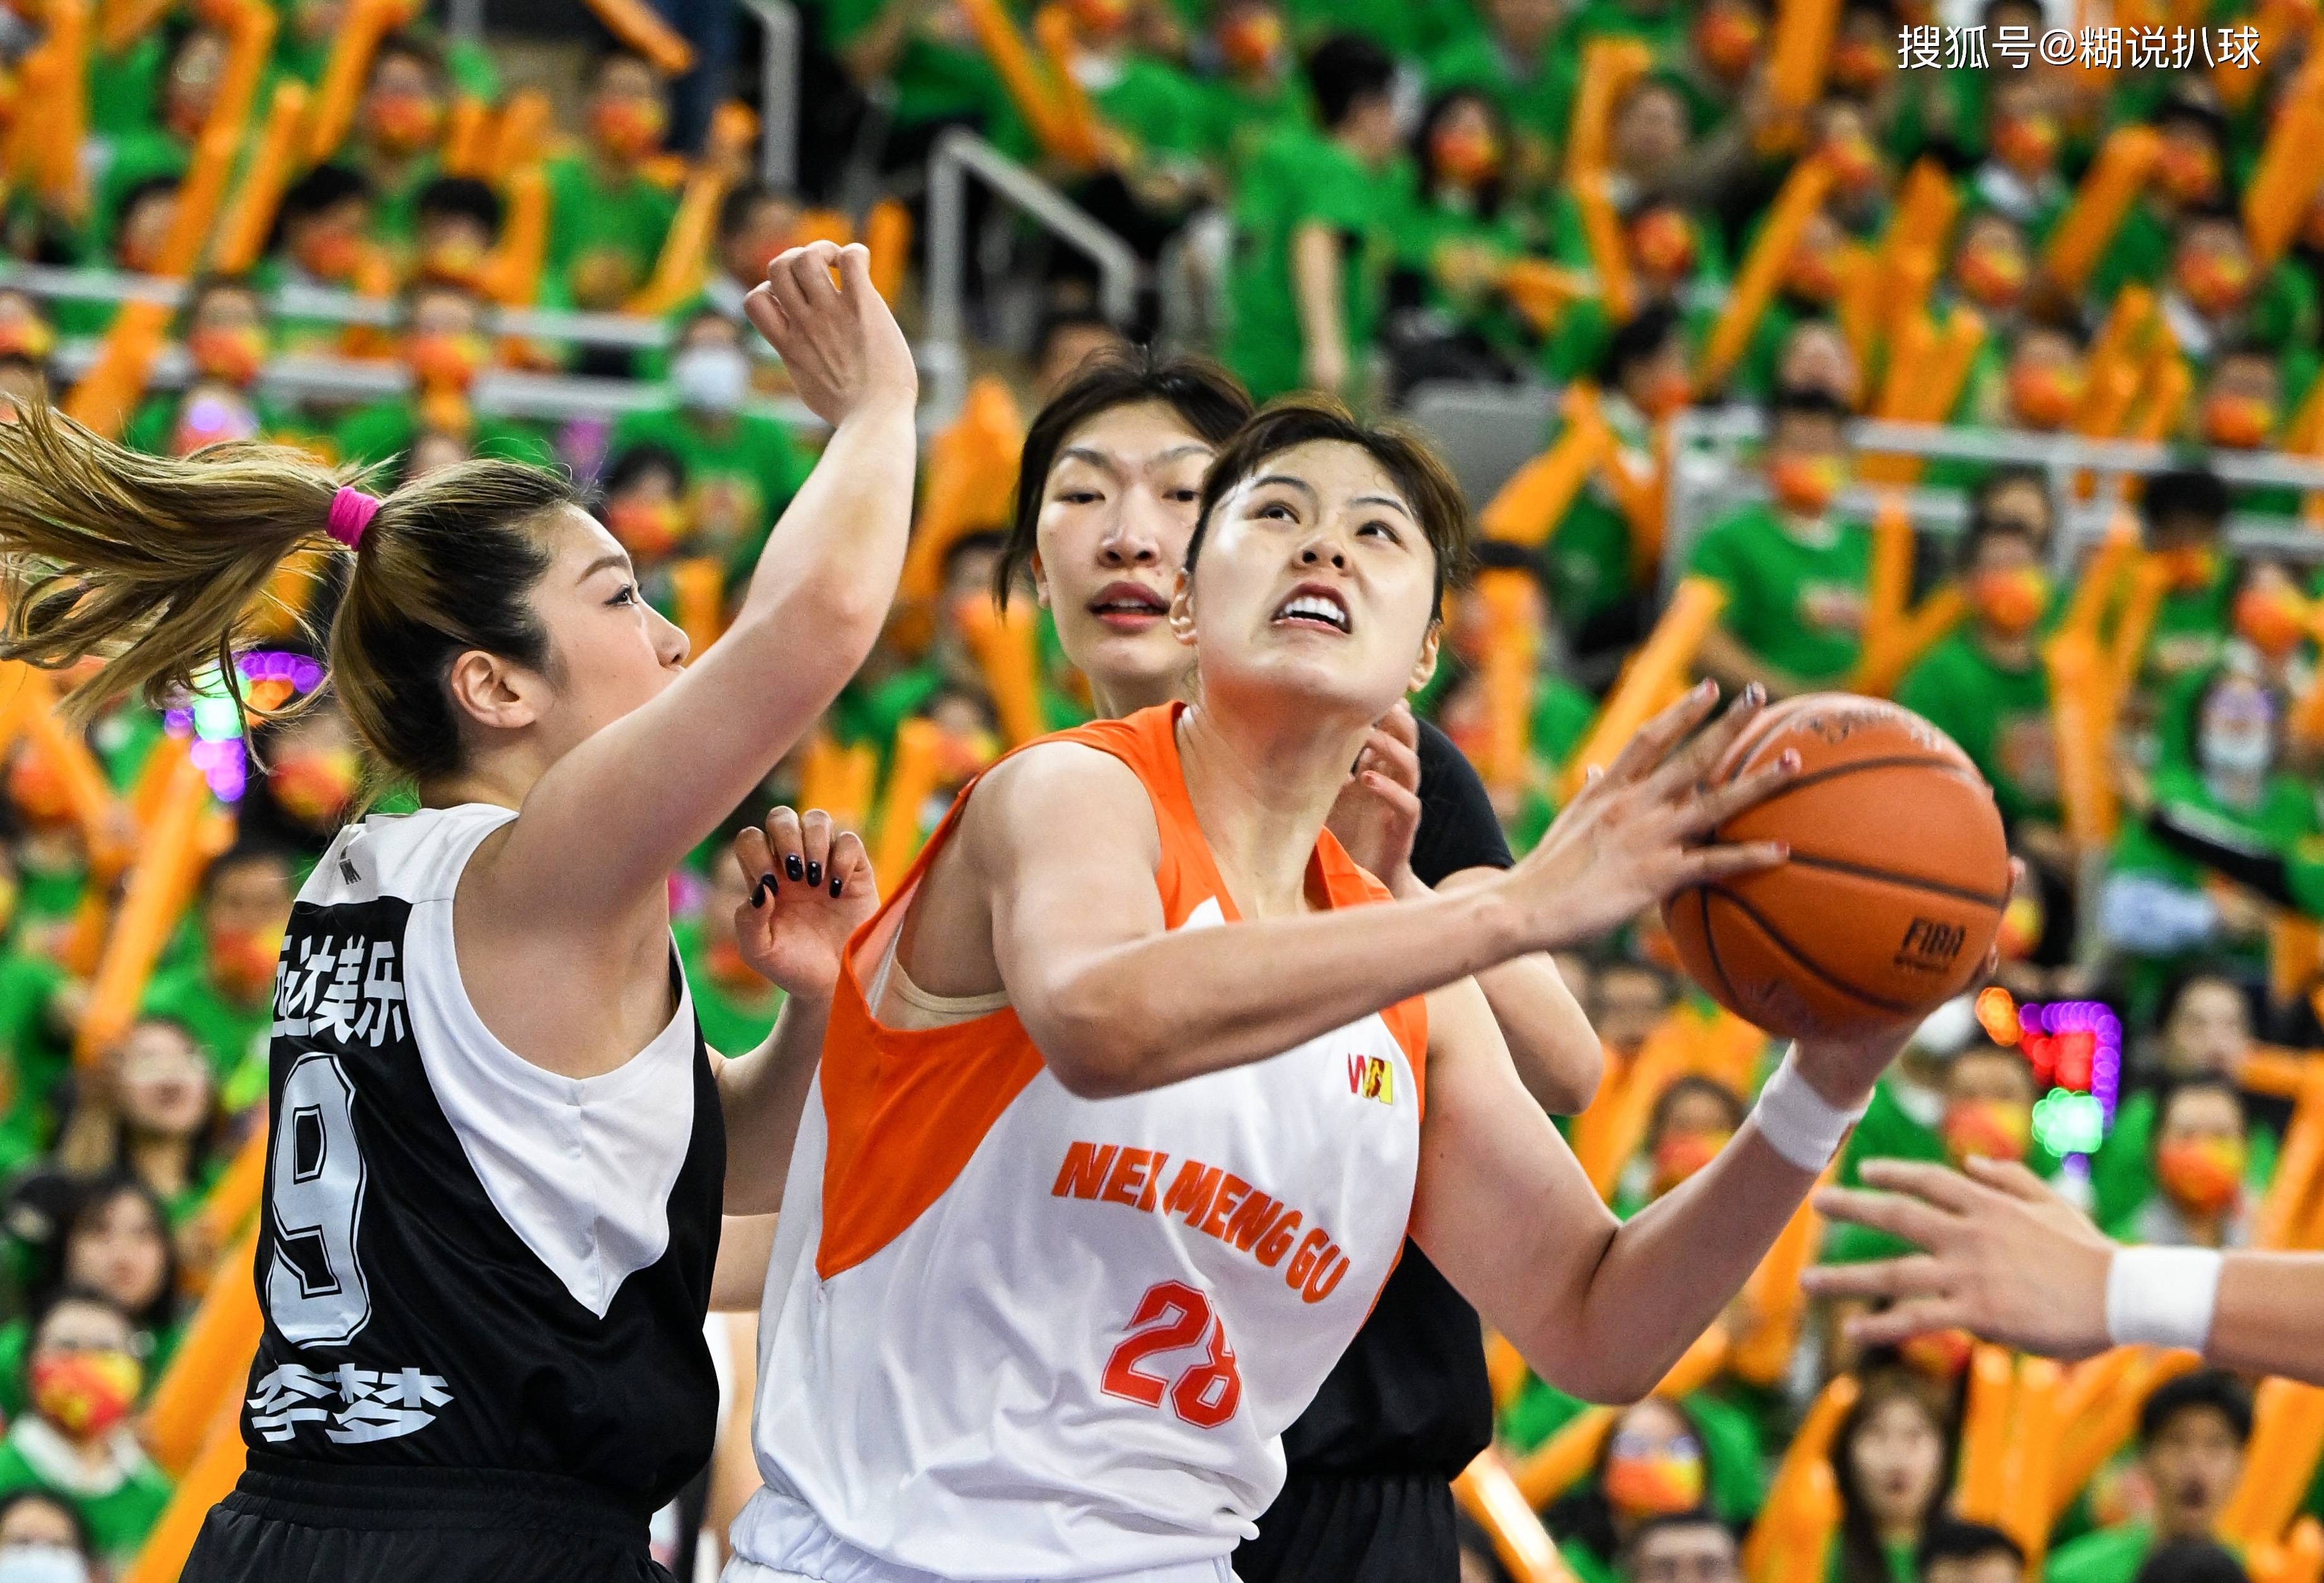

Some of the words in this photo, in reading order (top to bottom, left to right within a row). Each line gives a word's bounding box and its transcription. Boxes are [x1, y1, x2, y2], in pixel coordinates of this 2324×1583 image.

[266, 1051, 371, 1349] 9
[1051, 1141, 1169, 1213] NEI
[1162, 1159, 1302, 1268] MENG
[1285, 1227, 1350, 1304] GU
[247, 1363, 455, 1444] 李梦
[1100, 1279, 1242, 1430] 28
